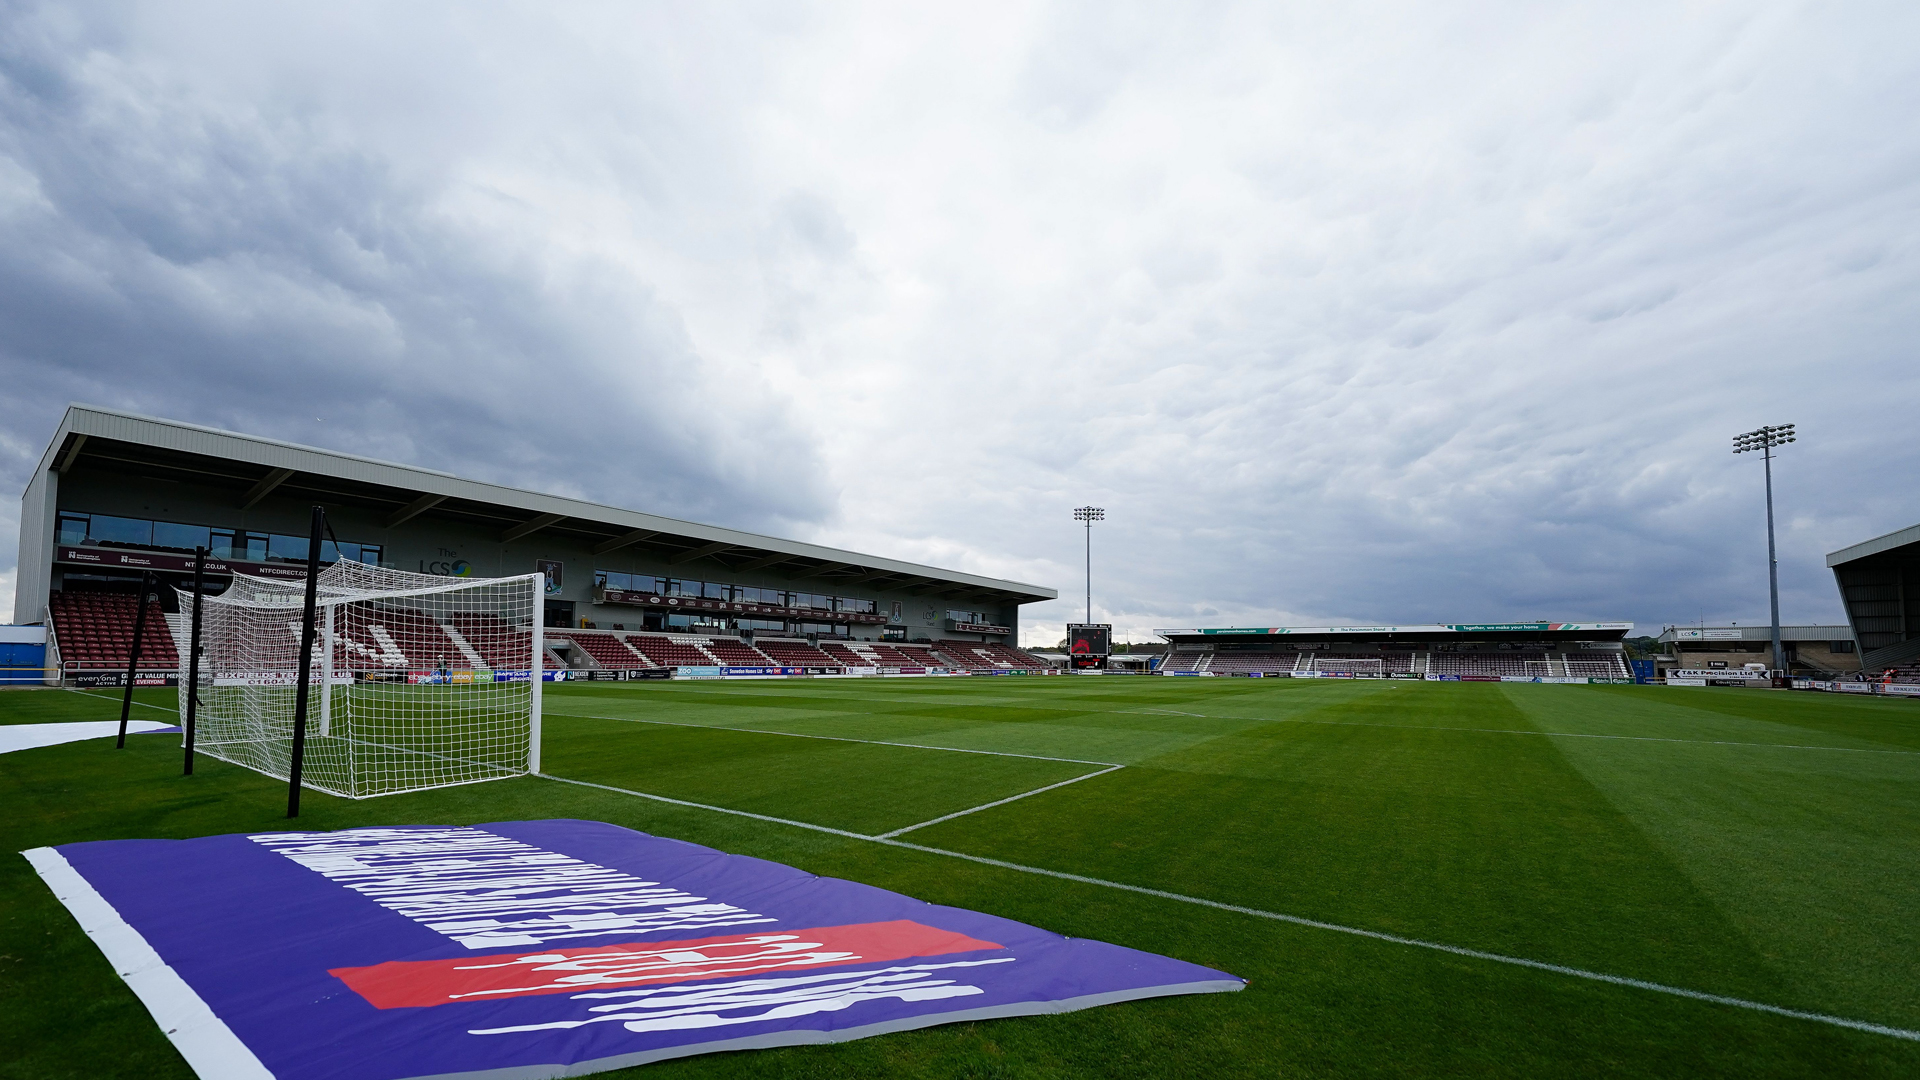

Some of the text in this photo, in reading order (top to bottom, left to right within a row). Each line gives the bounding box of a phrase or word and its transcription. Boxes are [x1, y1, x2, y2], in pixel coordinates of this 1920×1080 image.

[437, 547, 457, 558] The
[185, 562, 226, 570] NT.CO.UK
[419, 560, 450, 577] LCS
[260, 568, 308, 577] NTFCDIRECT.CO
[922, 612, 932, 620] LCS
